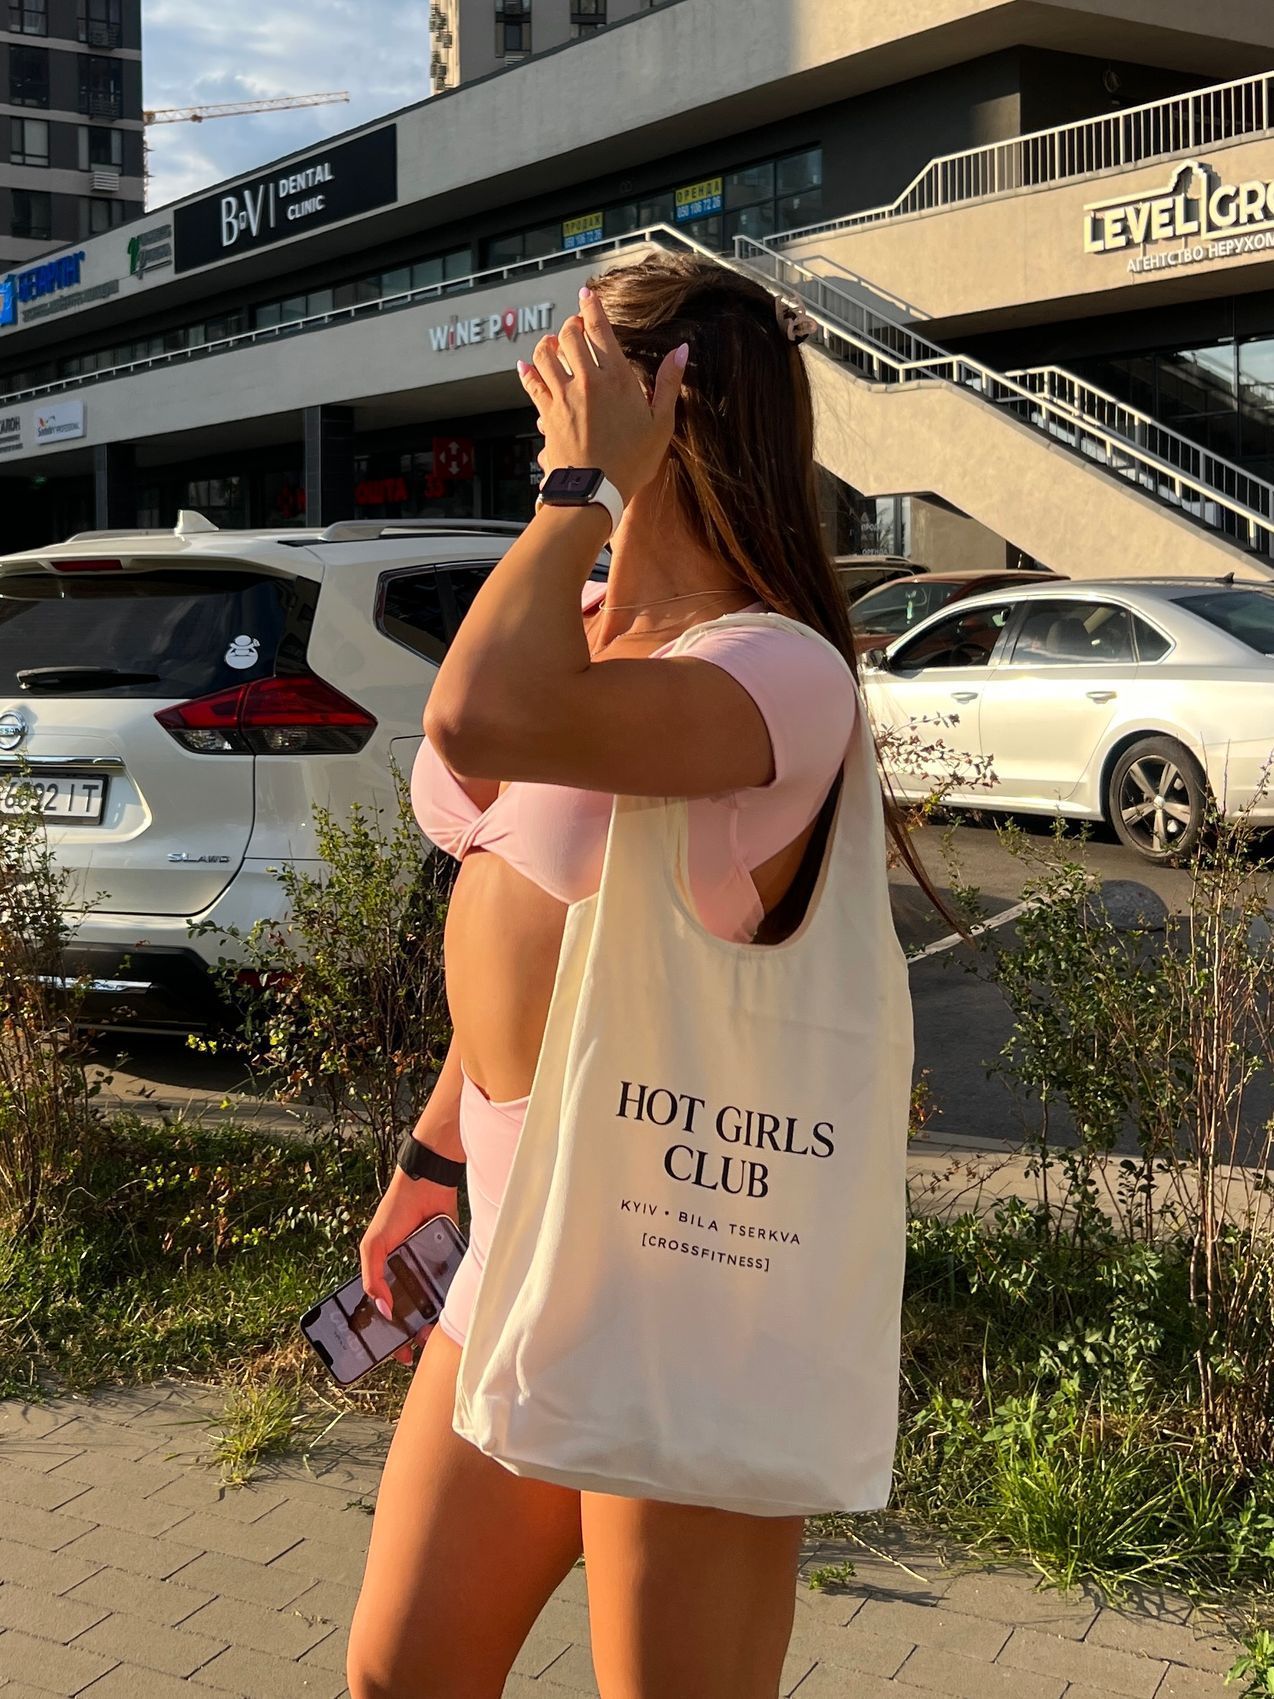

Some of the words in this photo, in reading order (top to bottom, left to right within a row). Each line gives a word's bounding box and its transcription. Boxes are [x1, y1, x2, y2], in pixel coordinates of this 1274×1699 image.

[279, 162, 335, 198] DENTAL
[676, 180, 721, 203] ОРЕНДА
[286, 195, 326, 221] CLINIC
[1083, 193, 1199, 254] LEVEL
[1126, 247, 1204, 273] АГЕНТСТВО
[489, 302, 552, 342] POINT
[615, 1080, 706, 1134] HOT
[715, 1105, 836, 1158] GIRLS
[663, 1144, 770, 1199] CLUB
[620, 1199, 658, 1217] KYIV
[678, 1211, 719, 1232] BILA
[729, 1223, 801, 1246] TSERKVA
[641, 1232, 771, 1273] [CROSSFITNESS]
